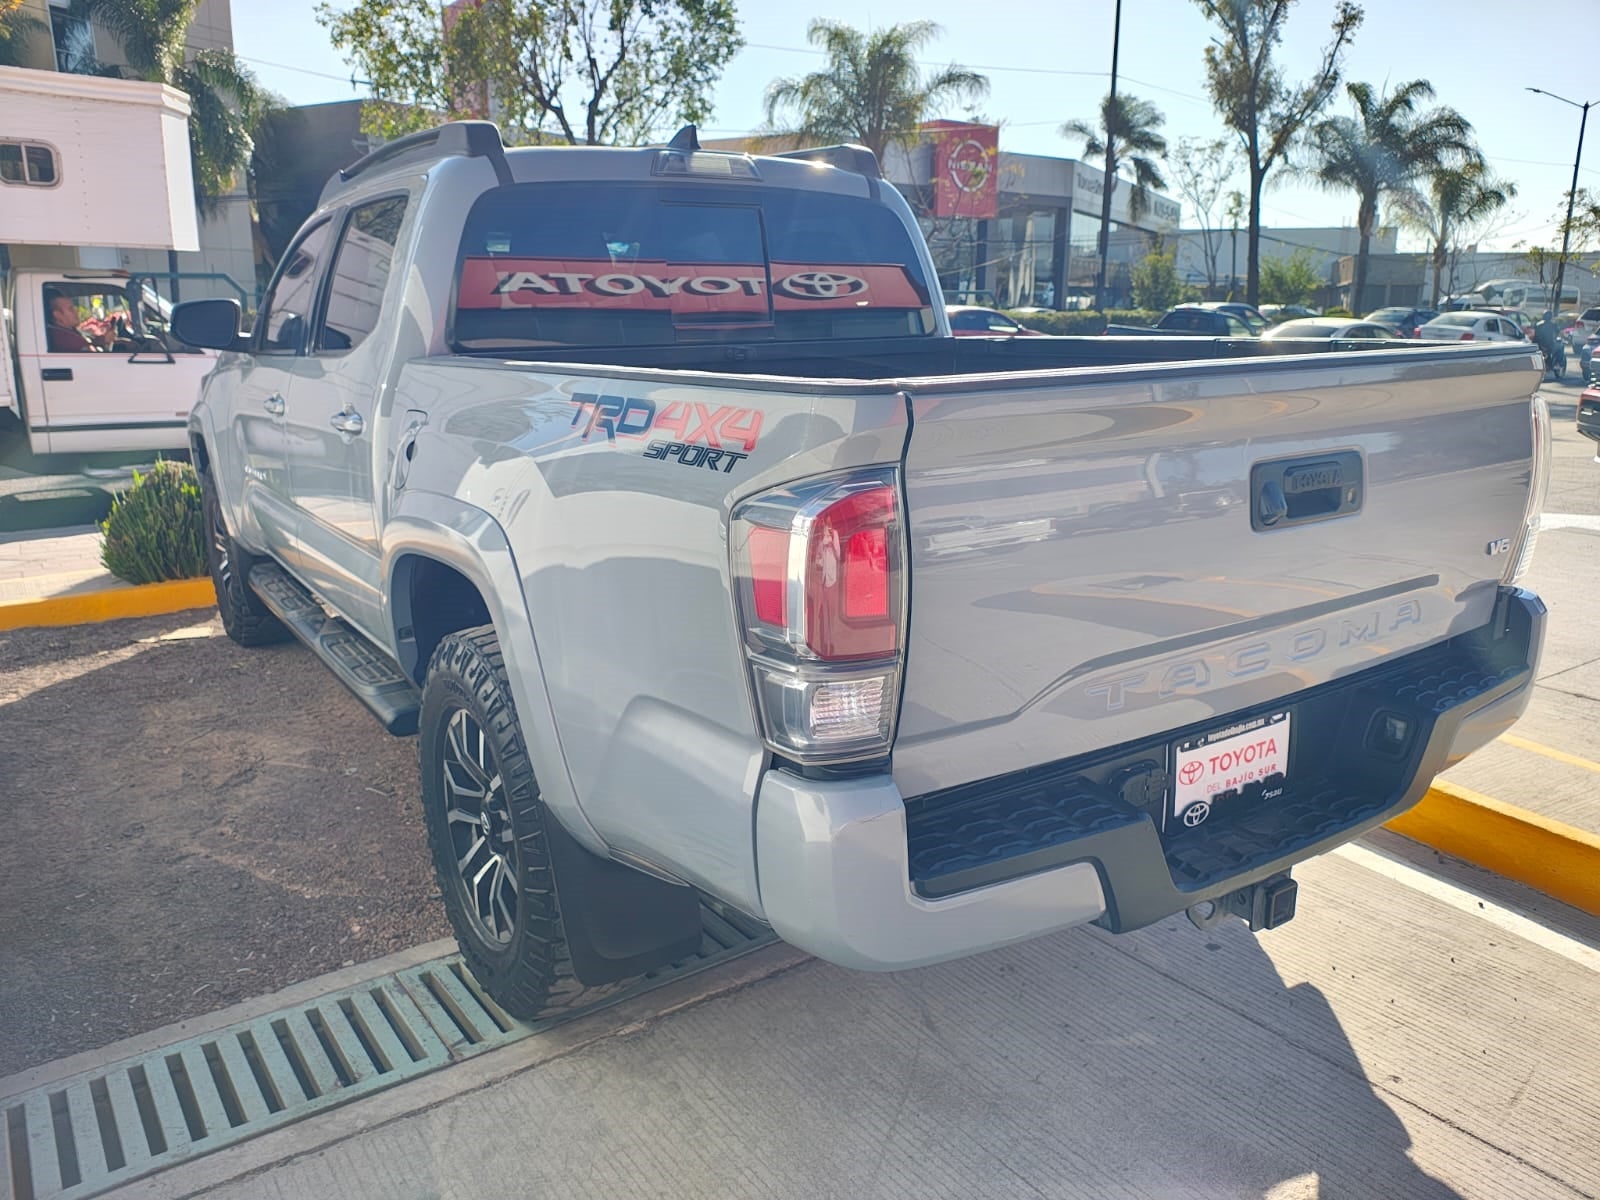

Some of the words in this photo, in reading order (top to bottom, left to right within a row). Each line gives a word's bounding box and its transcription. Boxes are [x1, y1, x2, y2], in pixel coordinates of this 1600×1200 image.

[569, 392, 656, 448] TRD
[654, 400, 764, 452] 4X4
[643, 439, 749, 474] SPORT
[1292, 469, 1342, 490] TOYOTA
[1487, 538, 1511, 555] V6
[1084, 599, 1421, 711] TACOMA
[1209, 738, 1277, 775] TOYOTA
[1206, 783, 1221, 793] DEL
[1258, 763, 1276, 777] SUR
